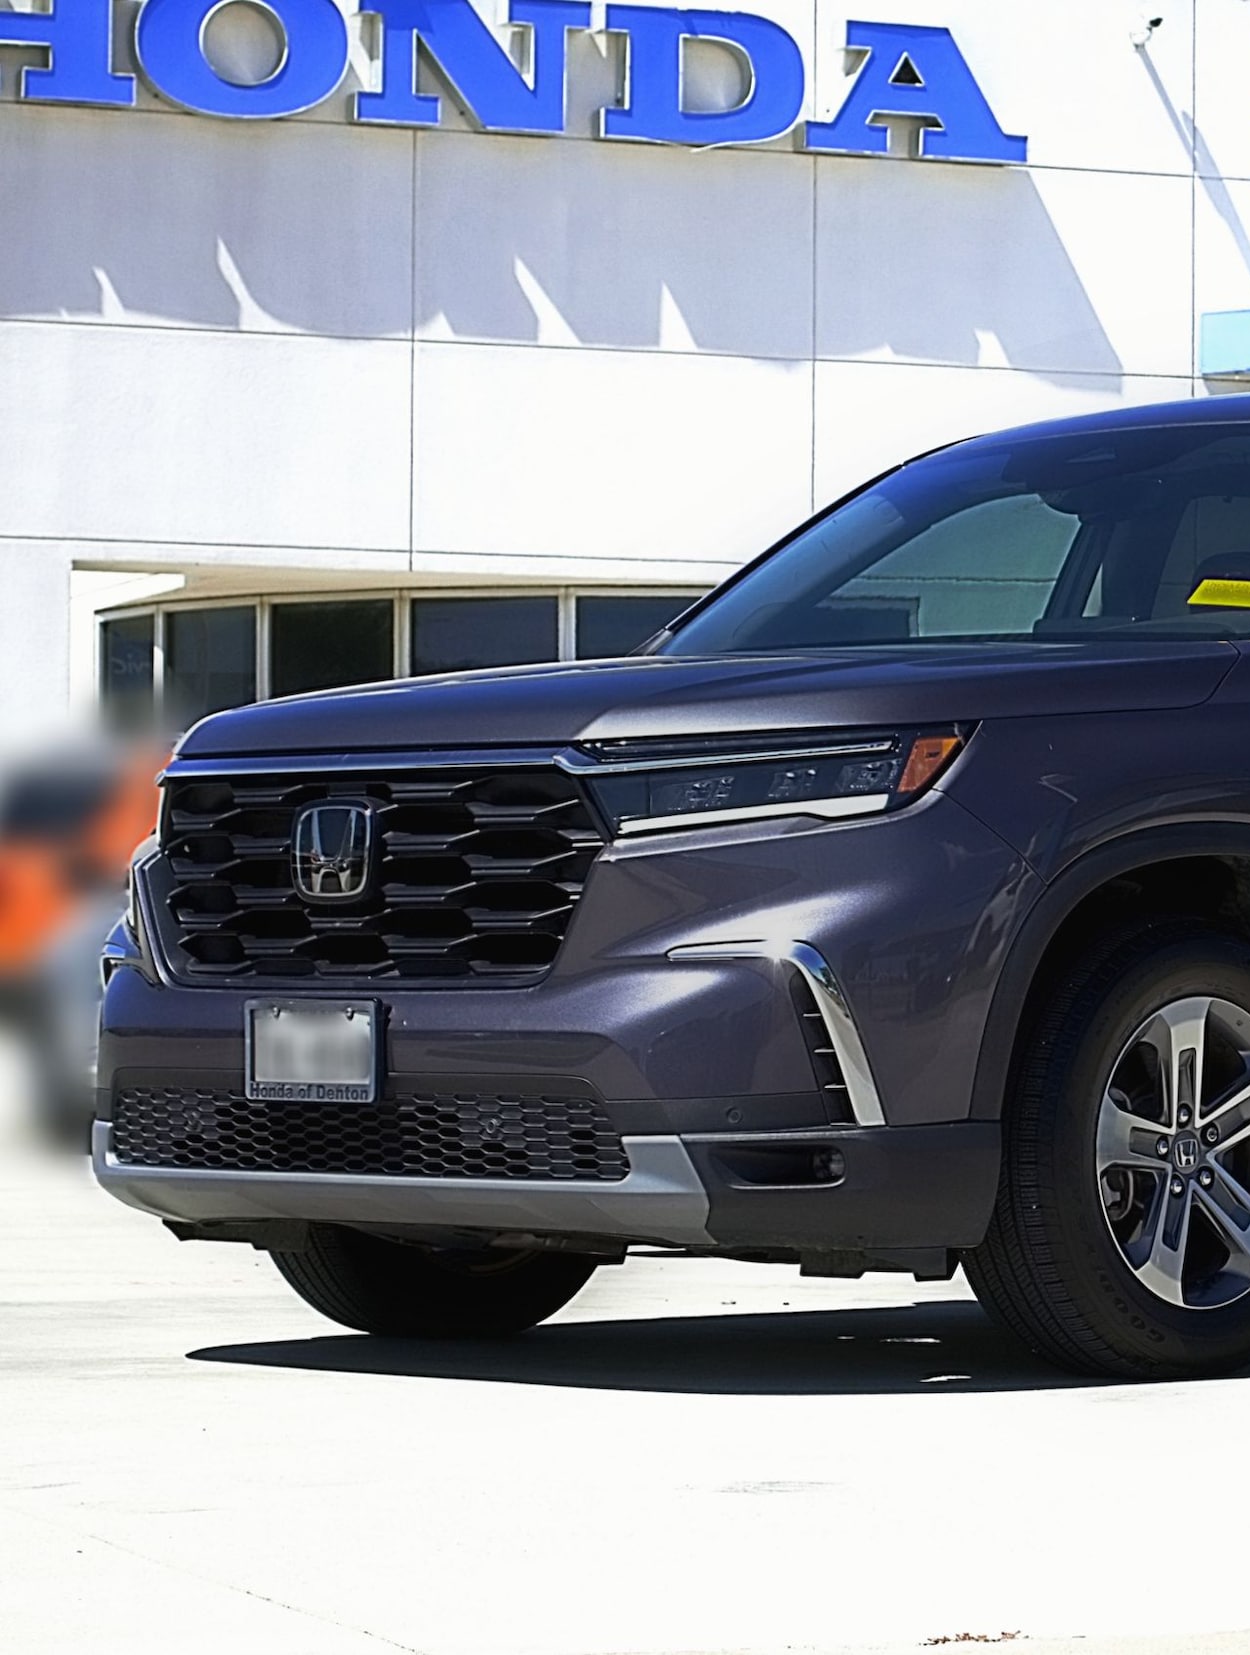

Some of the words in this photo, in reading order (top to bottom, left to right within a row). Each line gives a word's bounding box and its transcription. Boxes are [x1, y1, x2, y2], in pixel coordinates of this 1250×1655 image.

[249, 1082, 294, 1099] Honda
[299, 1084, 313, 1099] of
[316, 1085, 369, 1101] Denton
